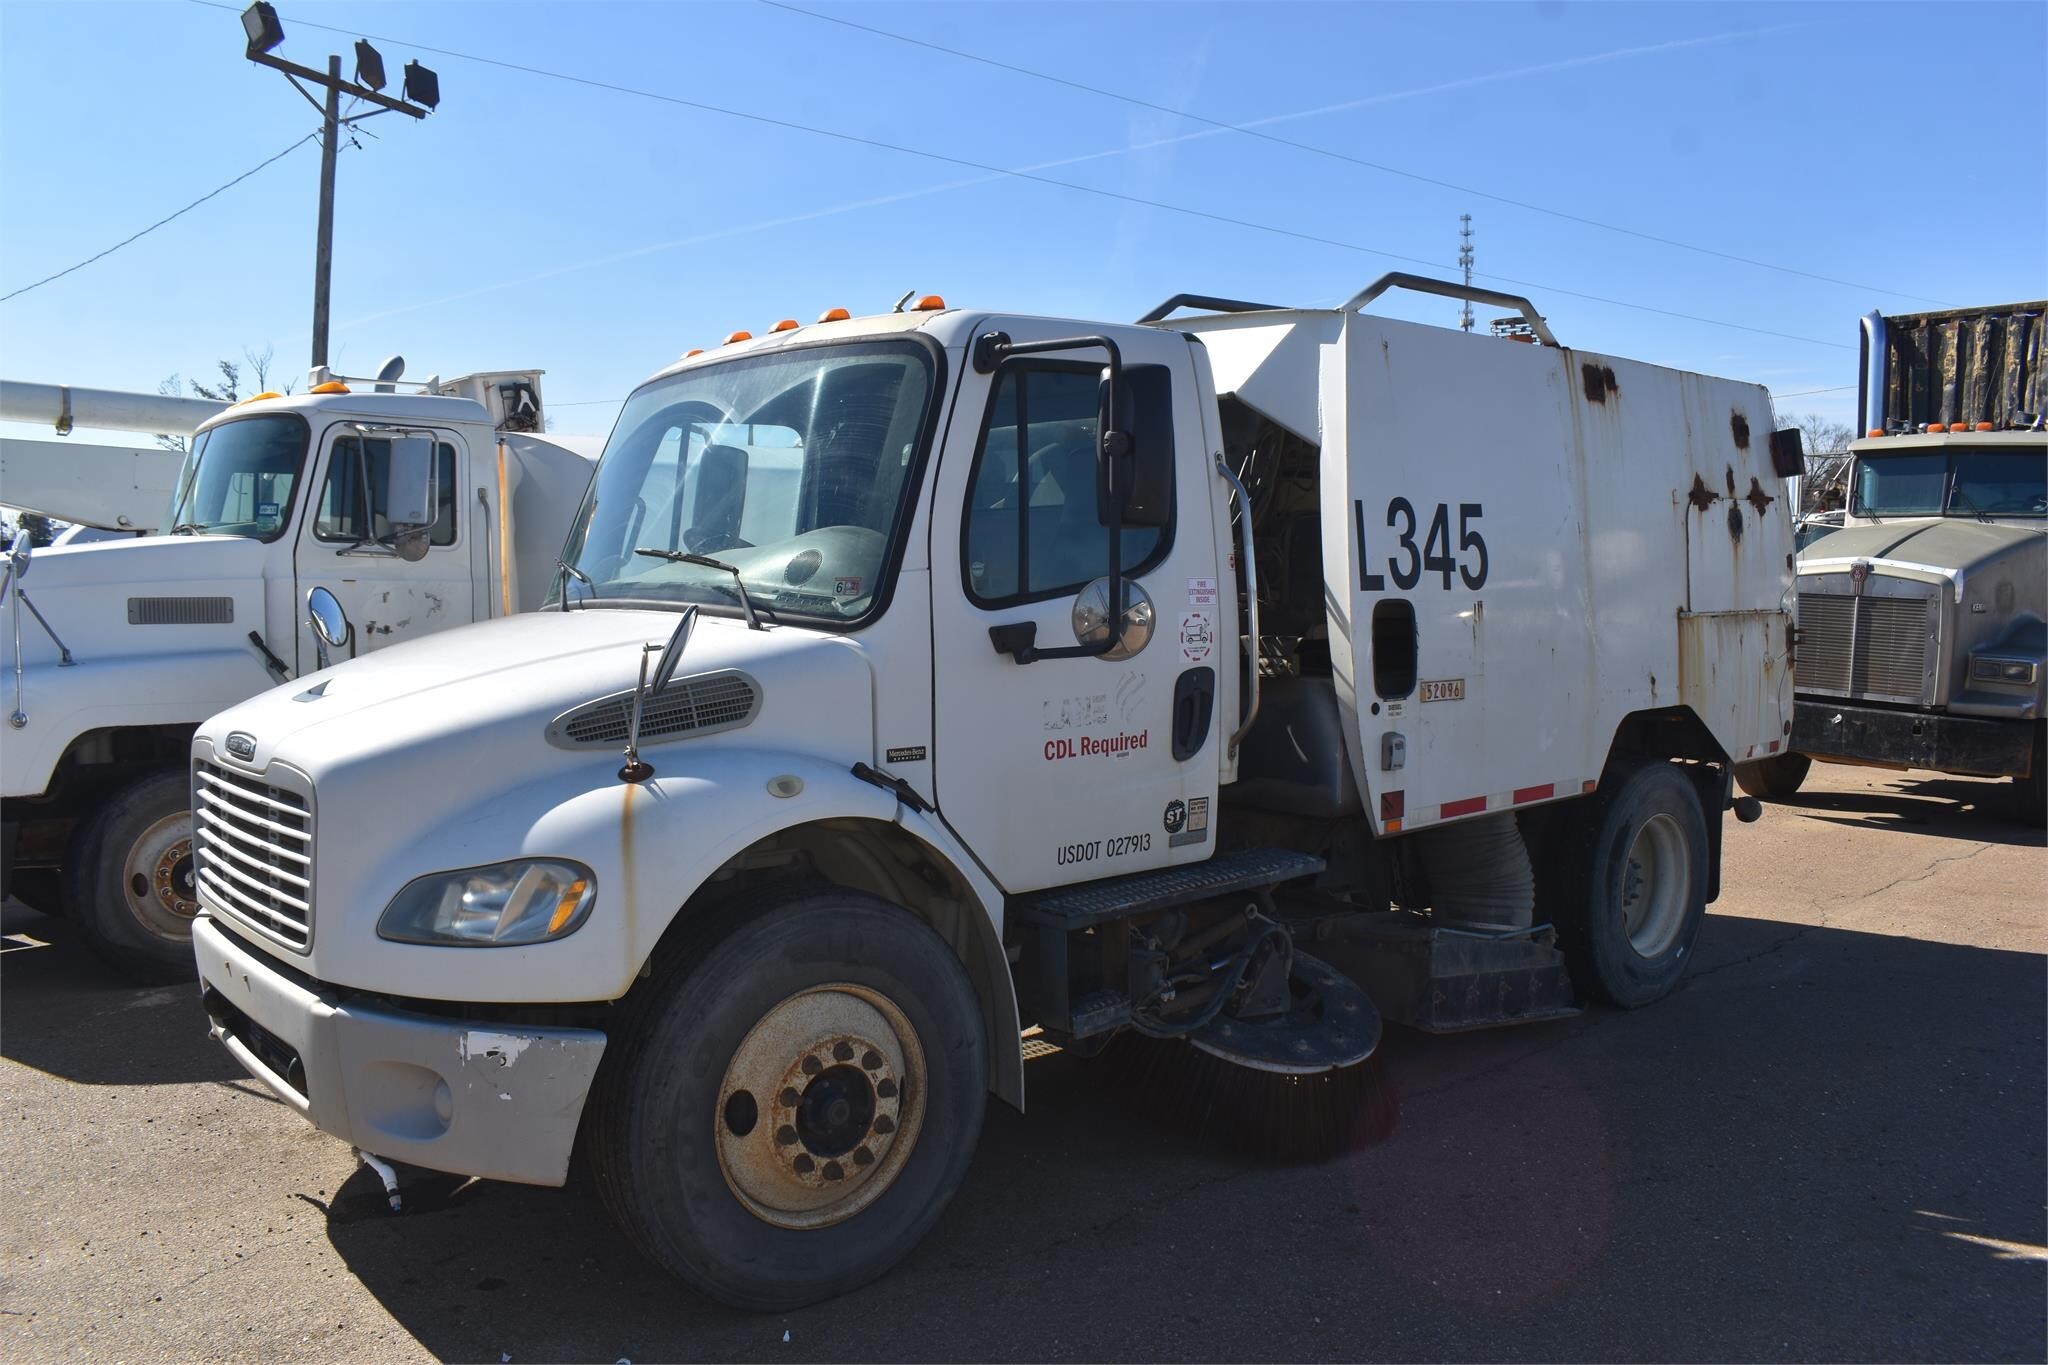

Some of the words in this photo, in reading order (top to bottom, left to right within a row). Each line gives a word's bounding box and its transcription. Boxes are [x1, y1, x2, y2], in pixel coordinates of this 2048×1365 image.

[1354, 496, 1489, 592] L345
[836, 582, 843, 593] 6
[1427, 682, 1459, 699] 52096
[1044, 738, 1076, 760] CDL
[1081, 729, 1147, 757] Required
[1166, 808, 1183, 824] ST
[1057, 841, 1101, 865] USDOT
[1107, 833, 1151, 857] 027913
